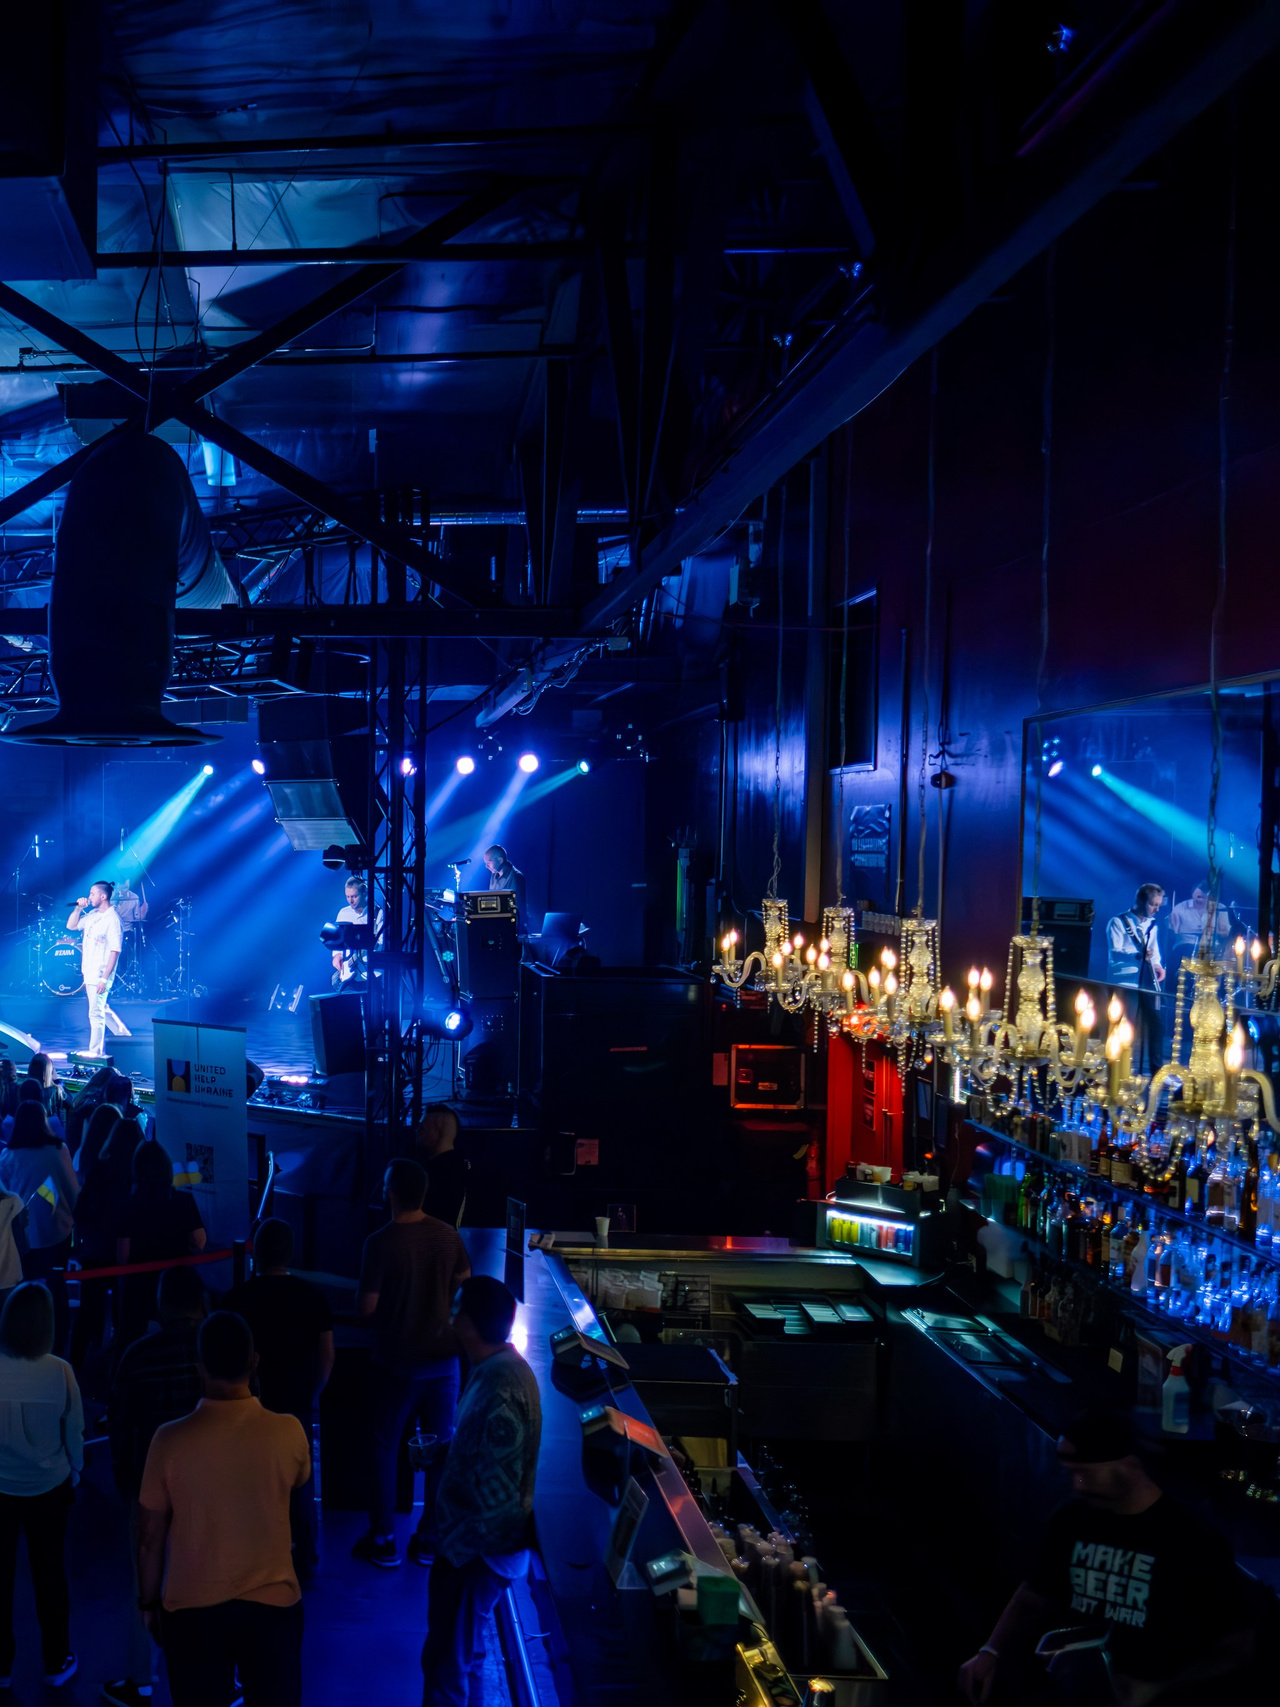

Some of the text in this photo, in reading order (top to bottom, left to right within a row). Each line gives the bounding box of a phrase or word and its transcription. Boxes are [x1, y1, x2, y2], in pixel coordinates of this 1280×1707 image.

[194, 1063, 226, 1075] UNITED
[194, 1074, 216, 1084] HELP
[194, 1085, 234, 1098] UKRAINE
[1070, 1539, 1156, 1582] MAKE
[1069, 1566, 1151, 1611] BEER
[1104, 1602, 1148, 1629] WAR
